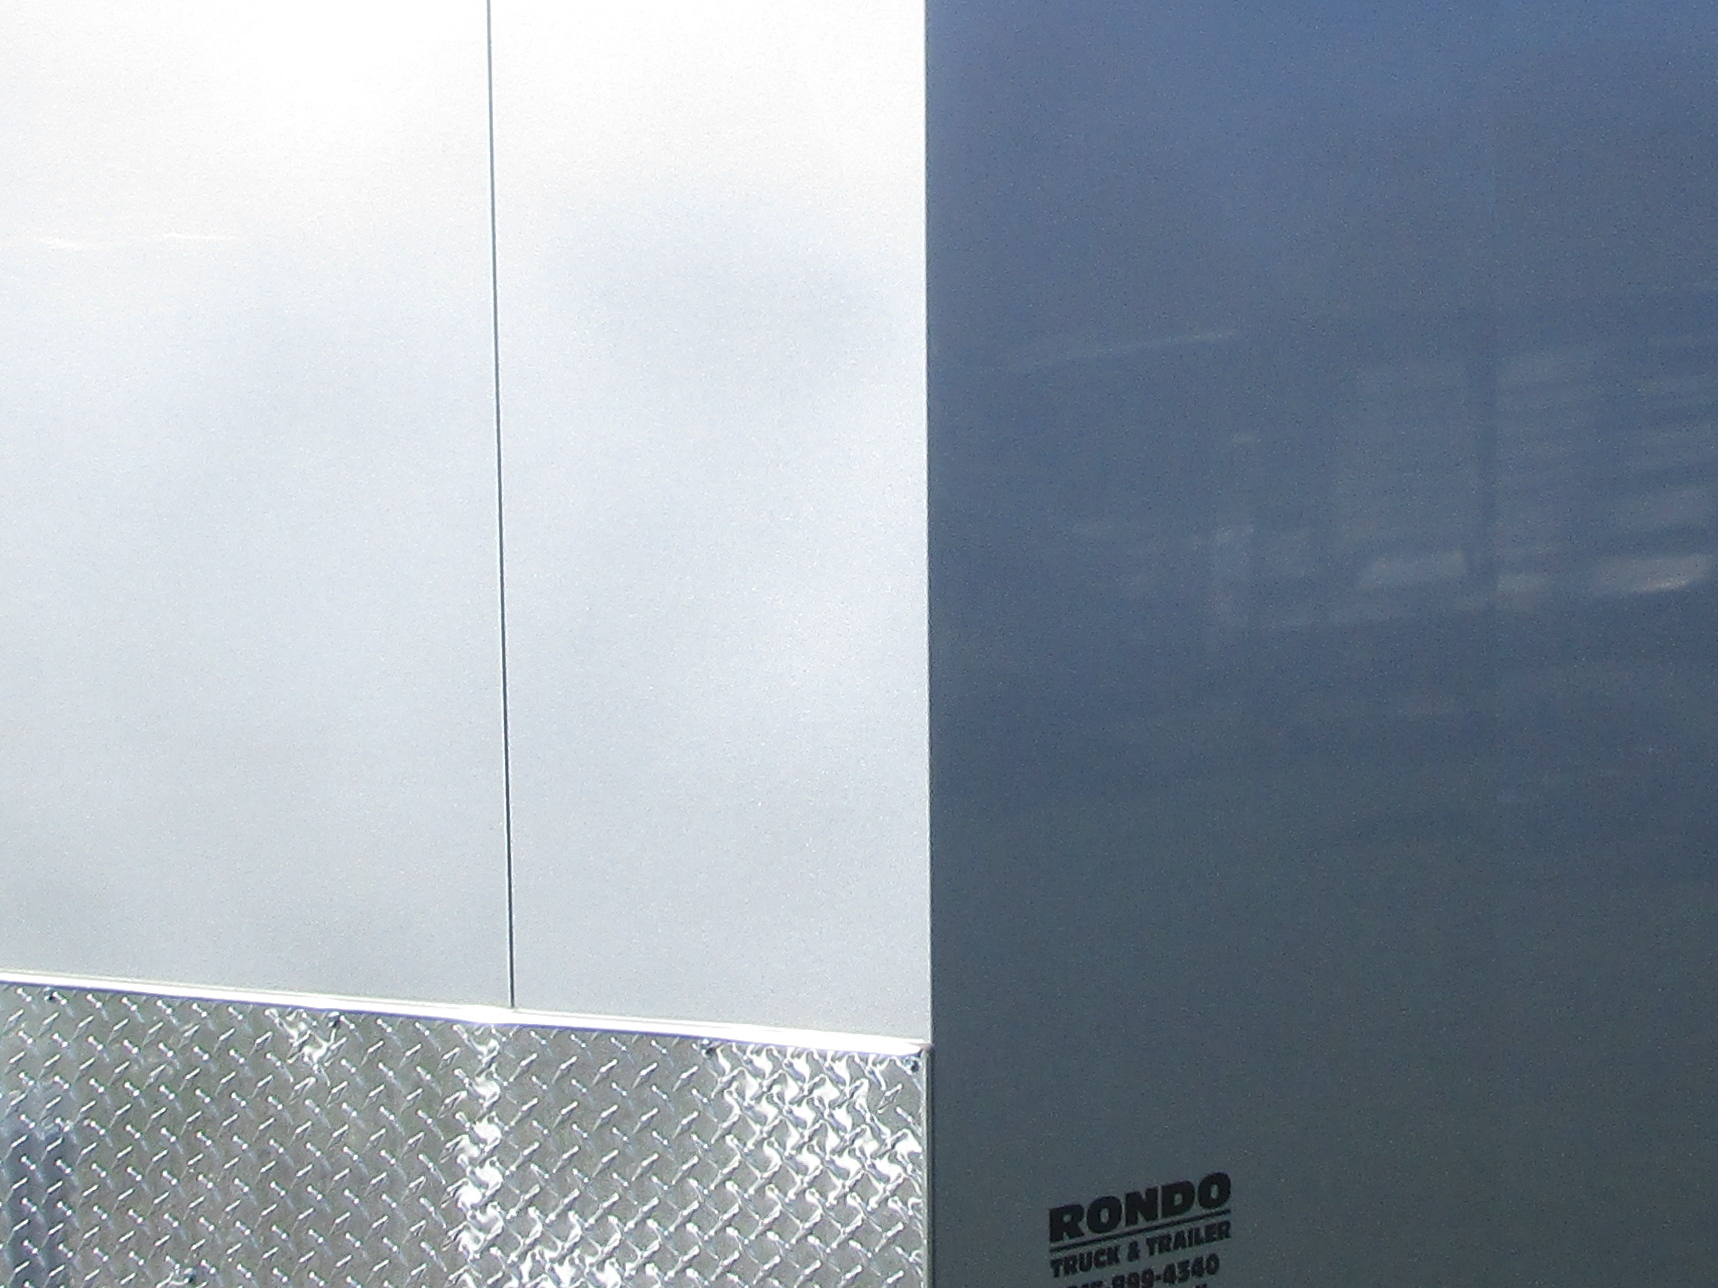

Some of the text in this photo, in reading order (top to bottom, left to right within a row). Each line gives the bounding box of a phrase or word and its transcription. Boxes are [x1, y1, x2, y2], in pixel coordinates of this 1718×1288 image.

[1049, 1171, 1232, 1243] RONDO
[1050, 1220, 1232, 1278] TRUCK & TRAILER
